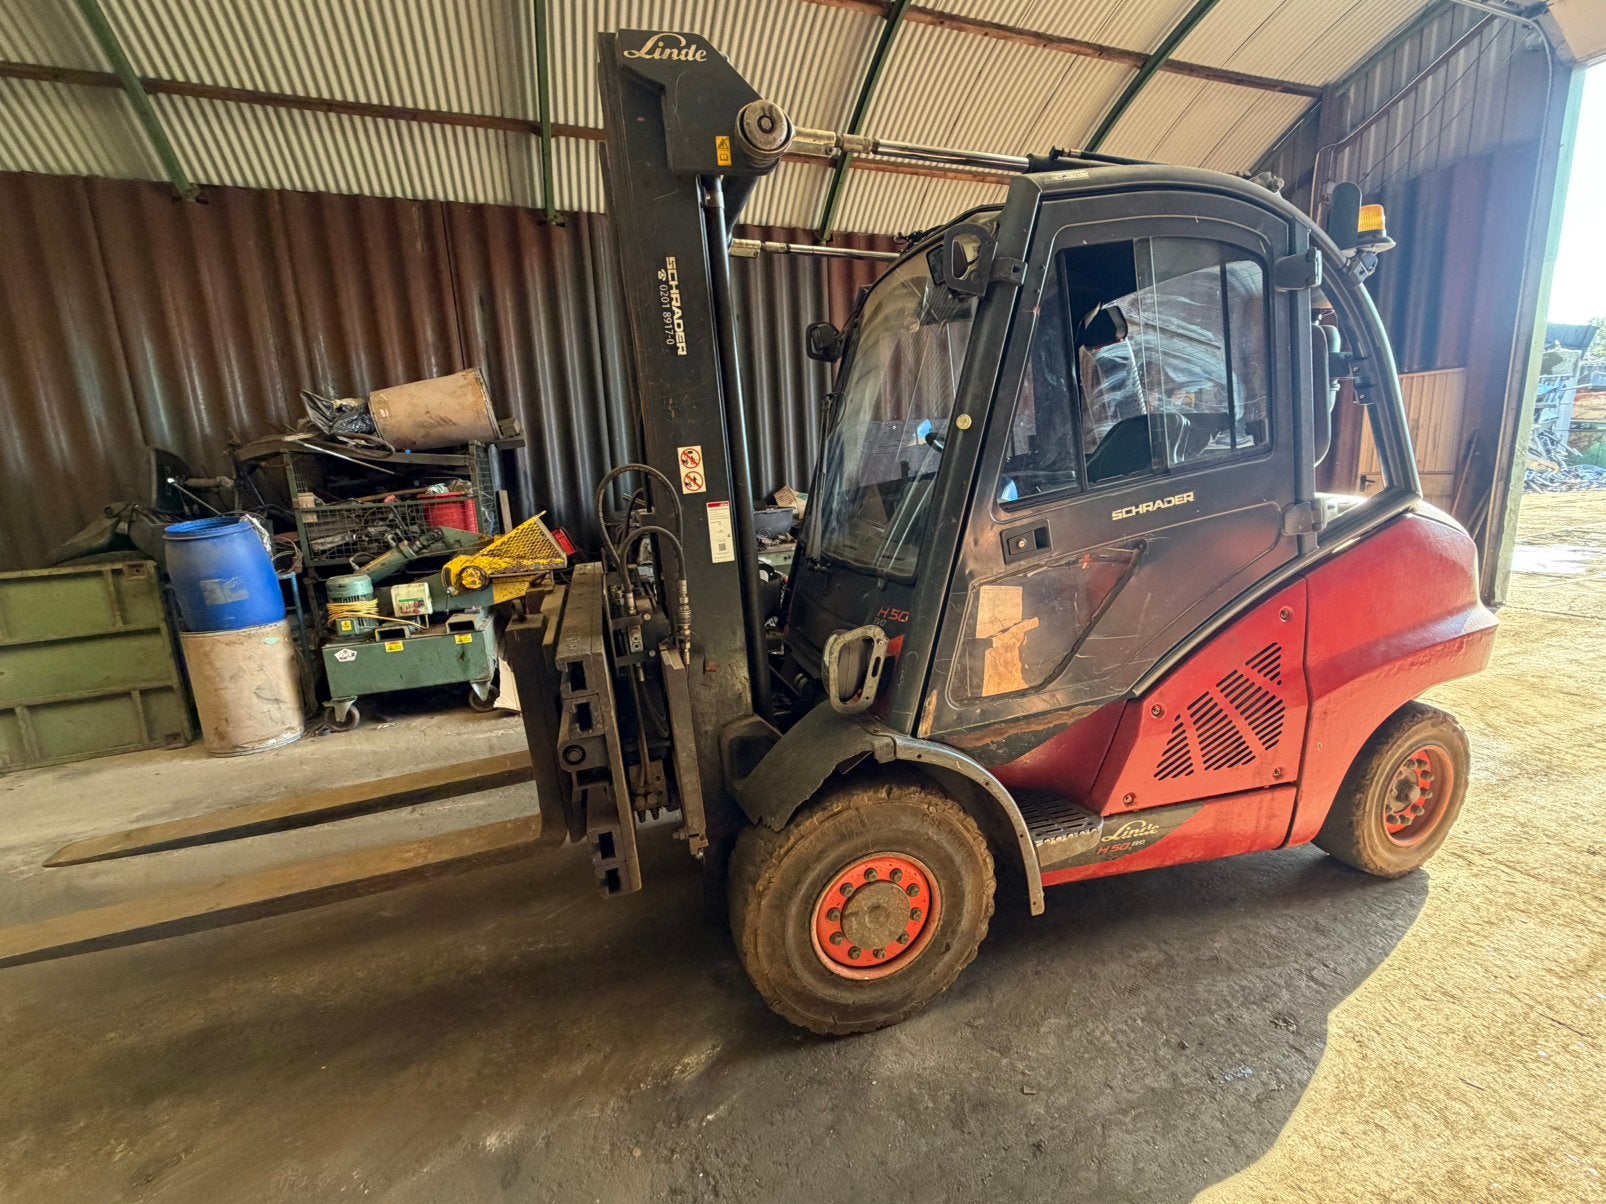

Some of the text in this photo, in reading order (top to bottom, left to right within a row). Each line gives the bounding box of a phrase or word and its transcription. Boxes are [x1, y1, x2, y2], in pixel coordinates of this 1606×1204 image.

[623, 32, 708, 62] Linde
[659, 284, 675, 345] 0201 8917-0
[665, 256, 688, 356] SCHRADER
[1111, 491, 1195, 521] SCHRADER
[1101, 820, 1160, 842] Linde
